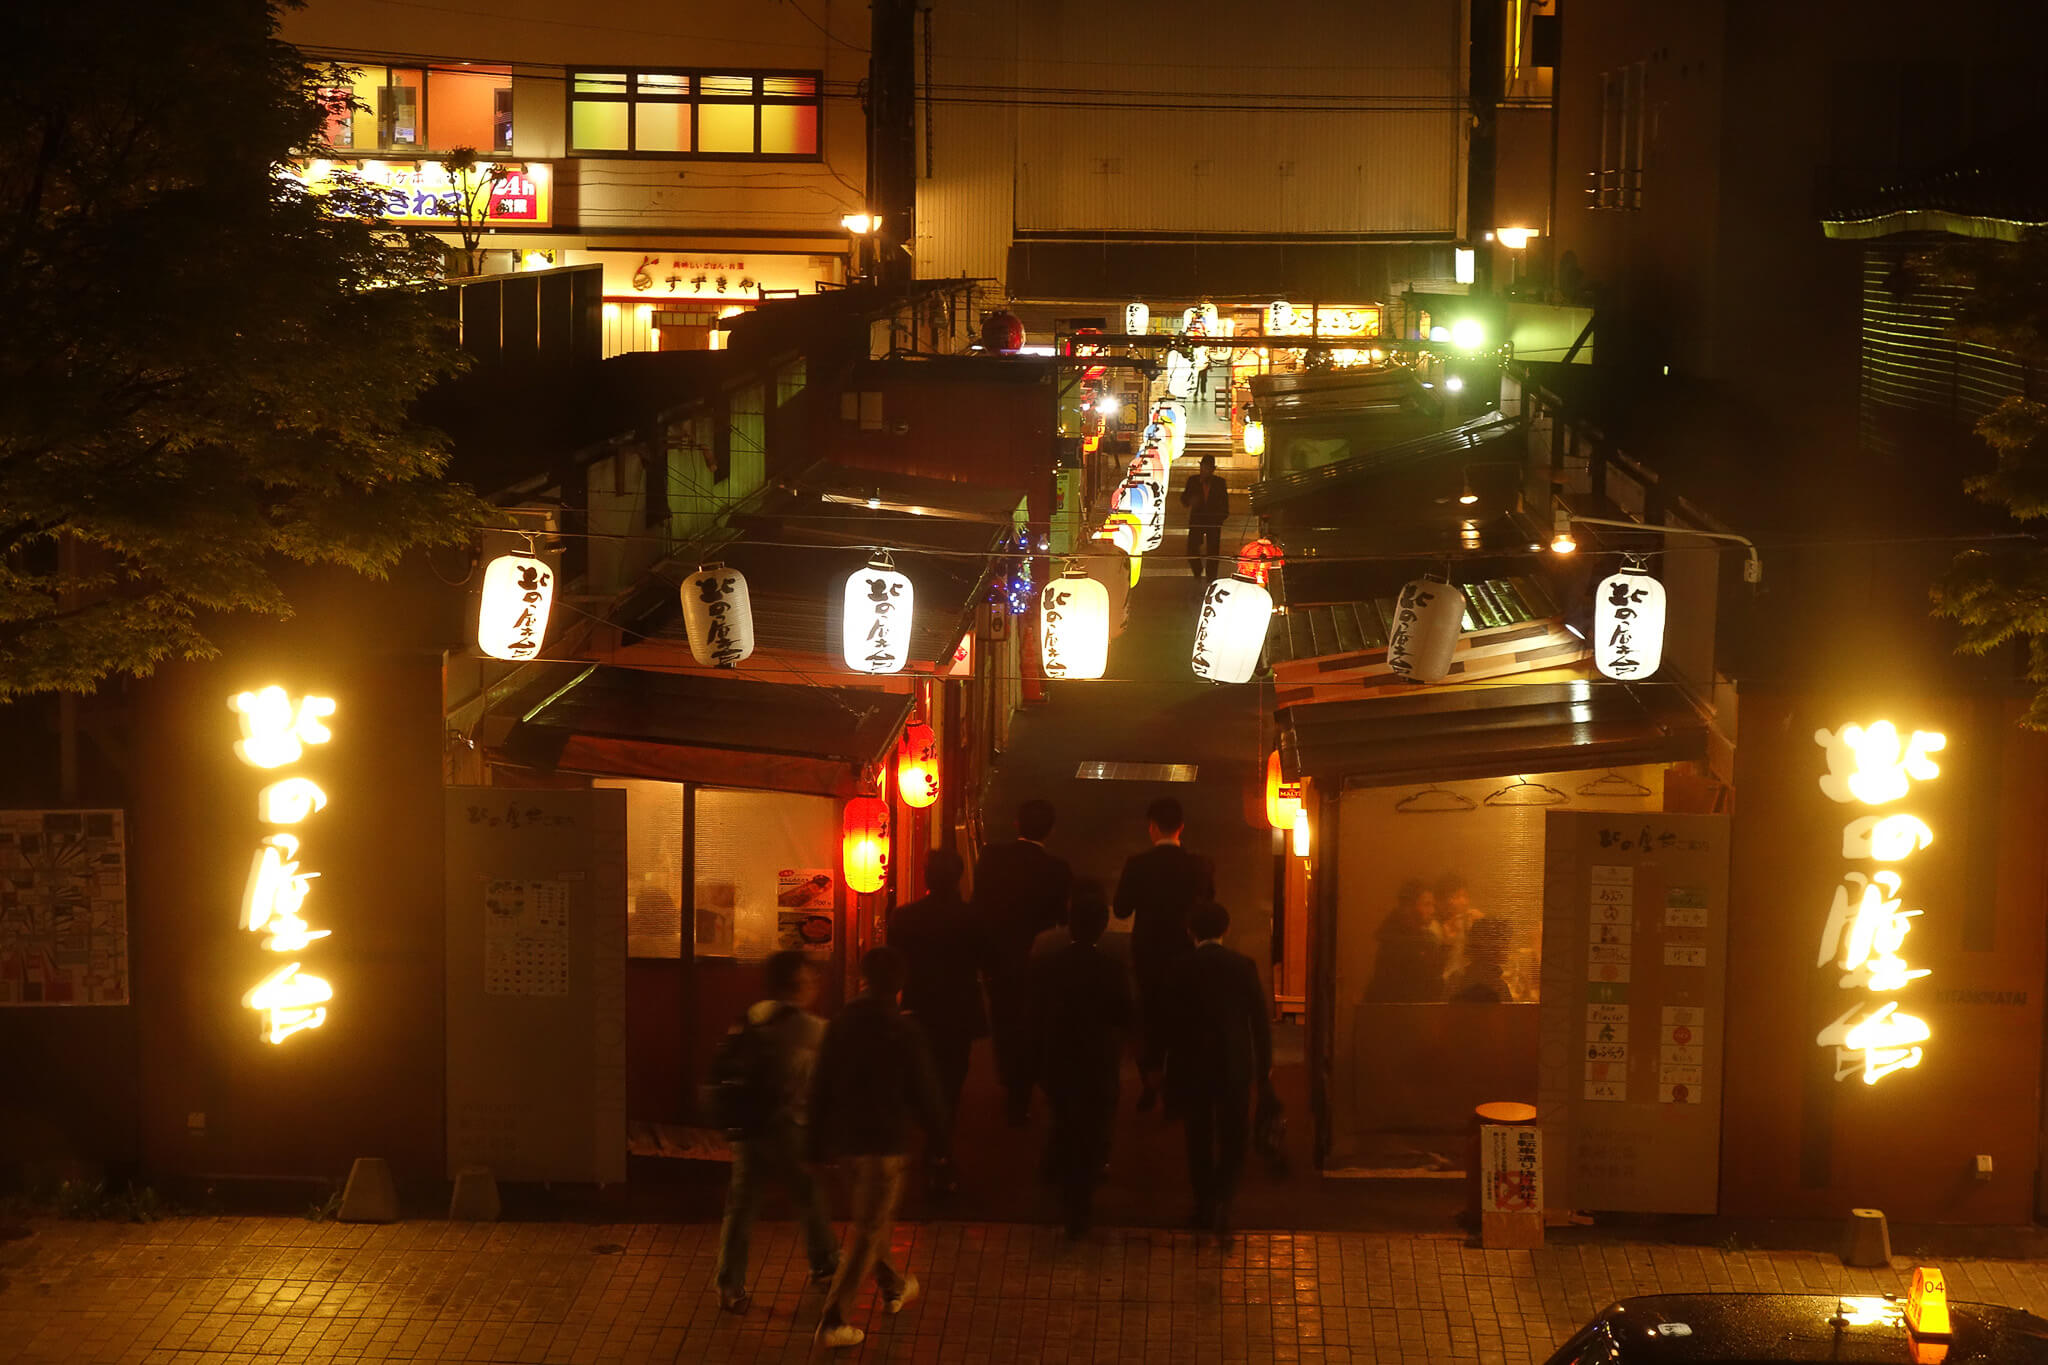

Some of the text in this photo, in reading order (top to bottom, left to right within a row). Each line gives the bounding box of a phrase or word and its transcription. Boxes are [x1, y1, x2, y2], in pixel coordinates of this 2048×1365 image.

[666, 276, 755, 294] すずきや
[508, 565, 550, 659] 北の屋台
[695, 577, 743, 669] 北の屋台
[865, 578, 904, 671] 北の屋台
[1608, 582, 1650, 677] 北の屋台
[228, 686, 337, 1044] 北の屋台
[1822, 719, 1947, 1085] 北の屋台
[1924, 1280, 1945, 1294] 04
